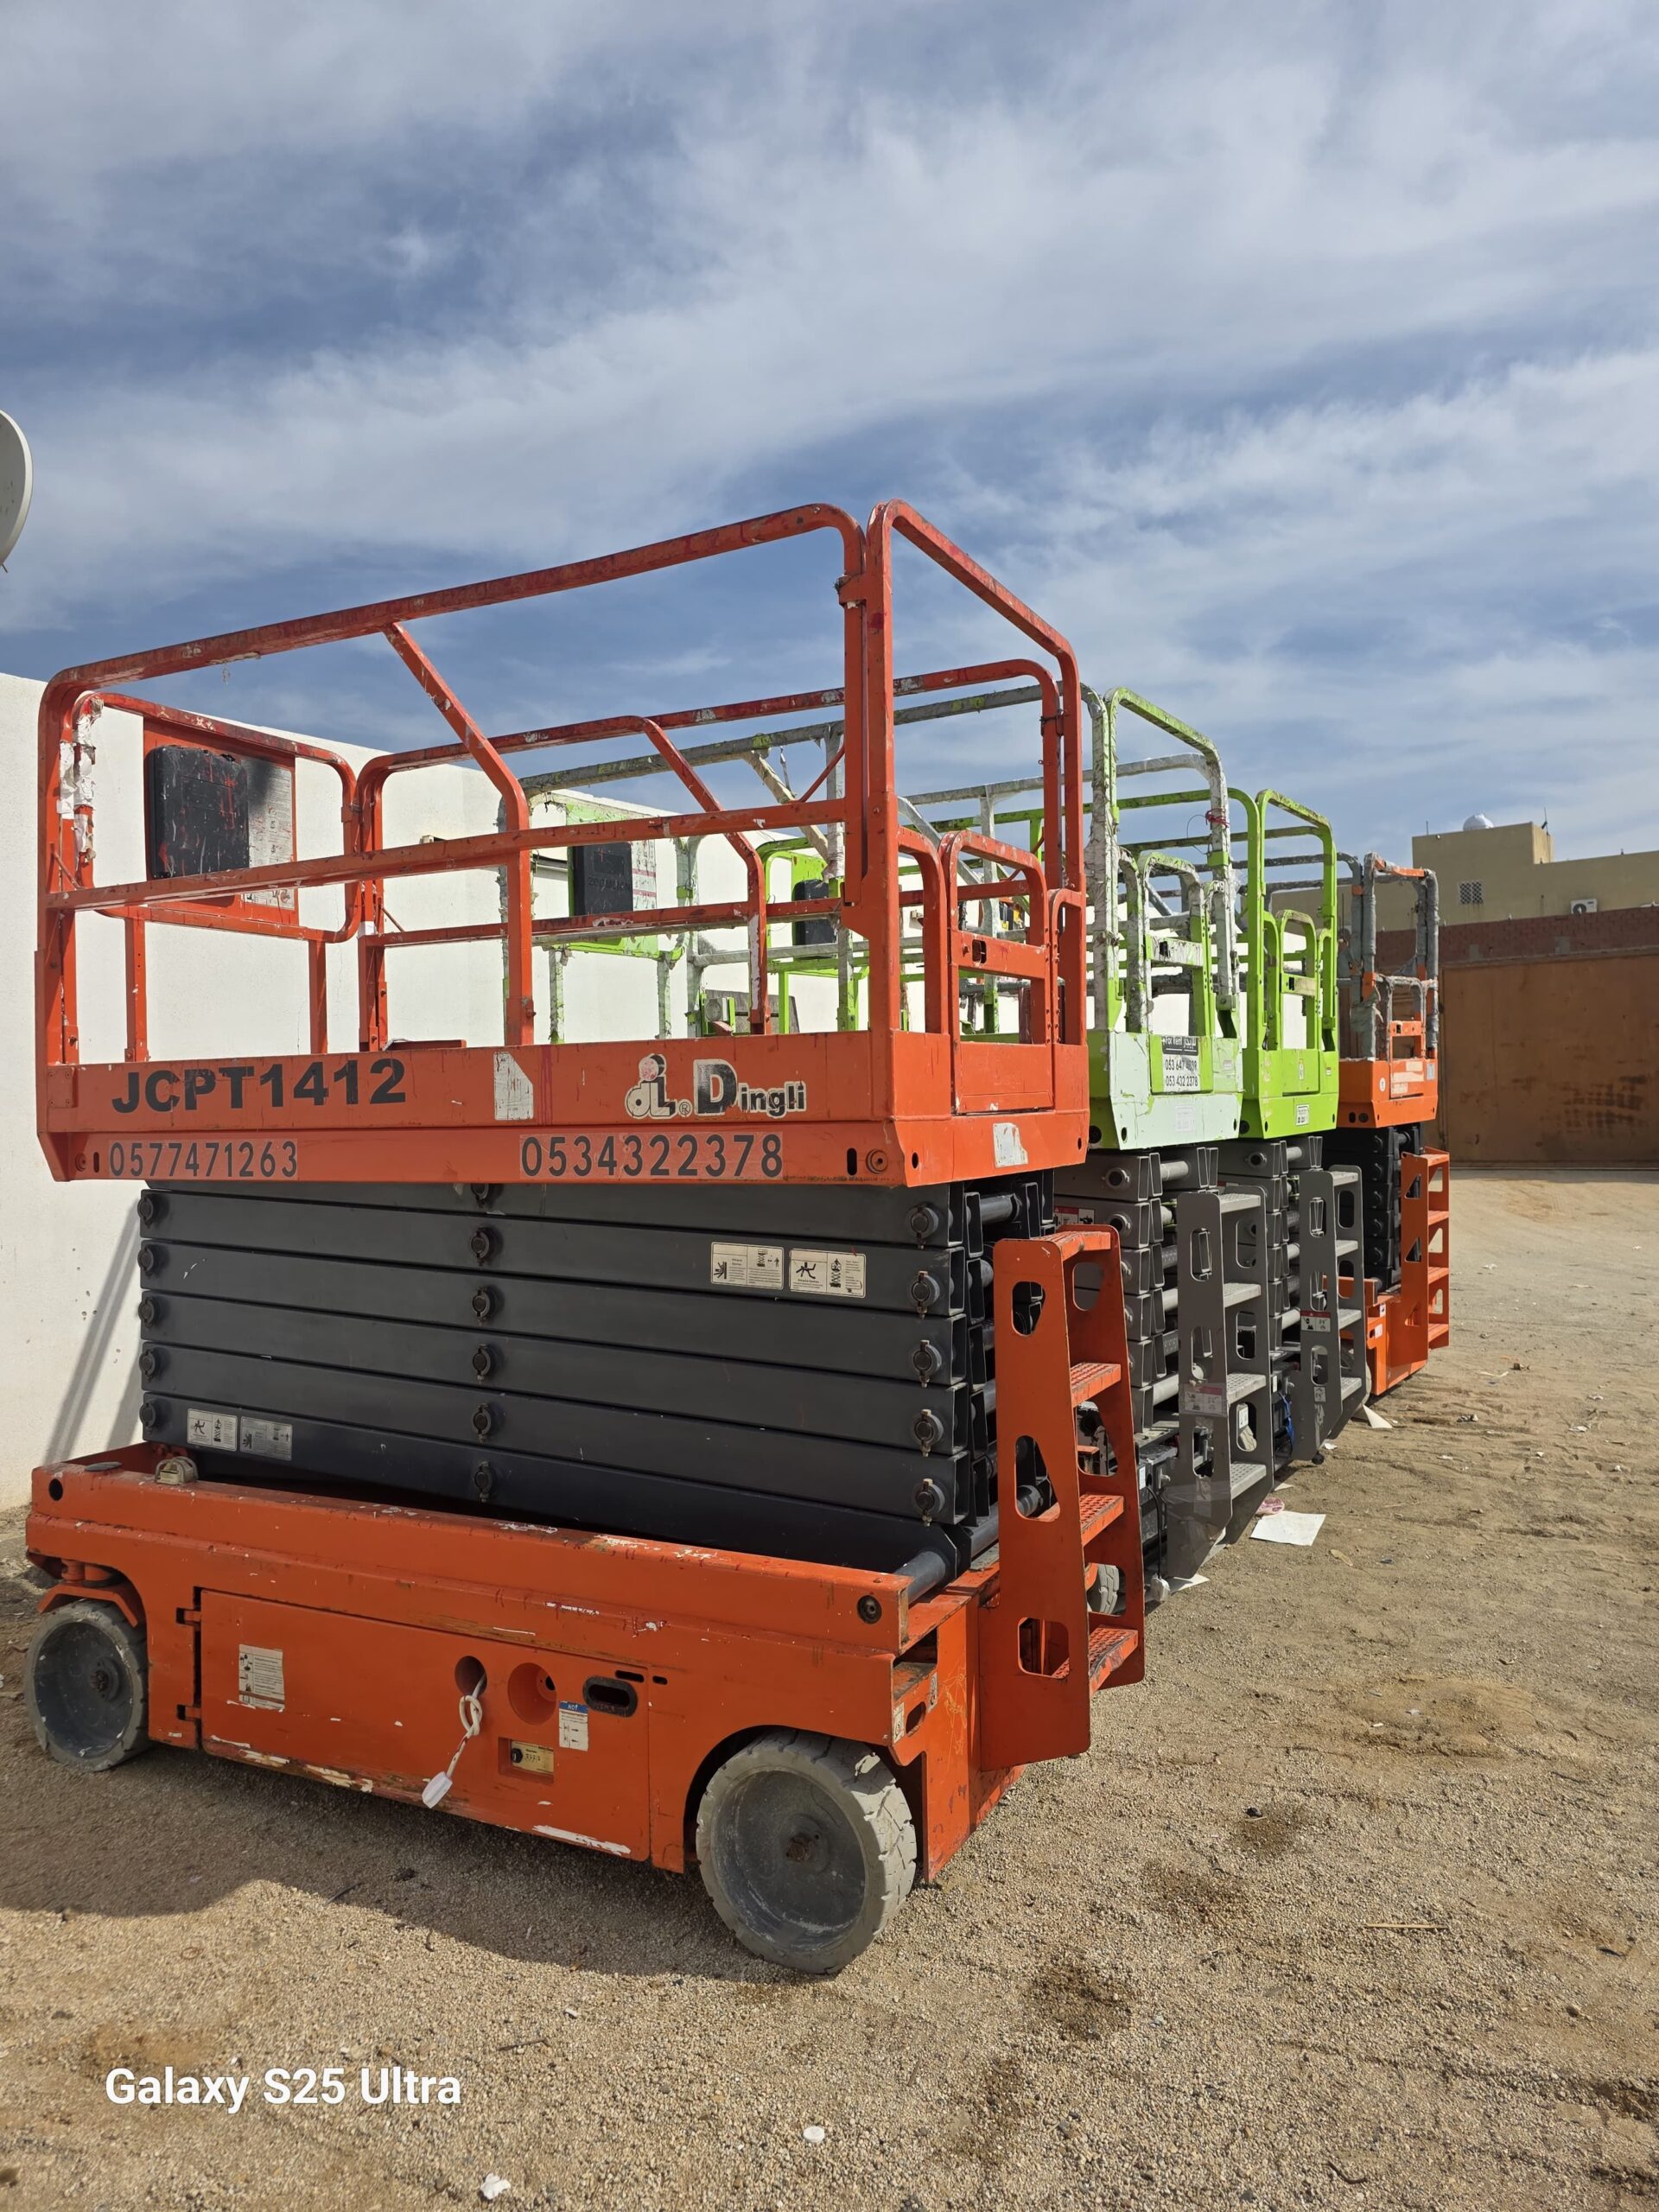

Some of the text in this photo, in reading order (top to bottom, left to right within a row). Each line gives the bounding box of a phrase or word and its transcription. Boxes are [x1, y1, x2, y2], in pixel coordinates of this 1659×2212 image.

[111, 1057, 407, 1115] JCPT1412
[696, 1063, 805, 1118] Dingli
[1186, 1075, 1198, 1087] 2378
[109, 1138, 298, 1178] 0577471263
[520, 1132, 784, 1178] 0534322378
